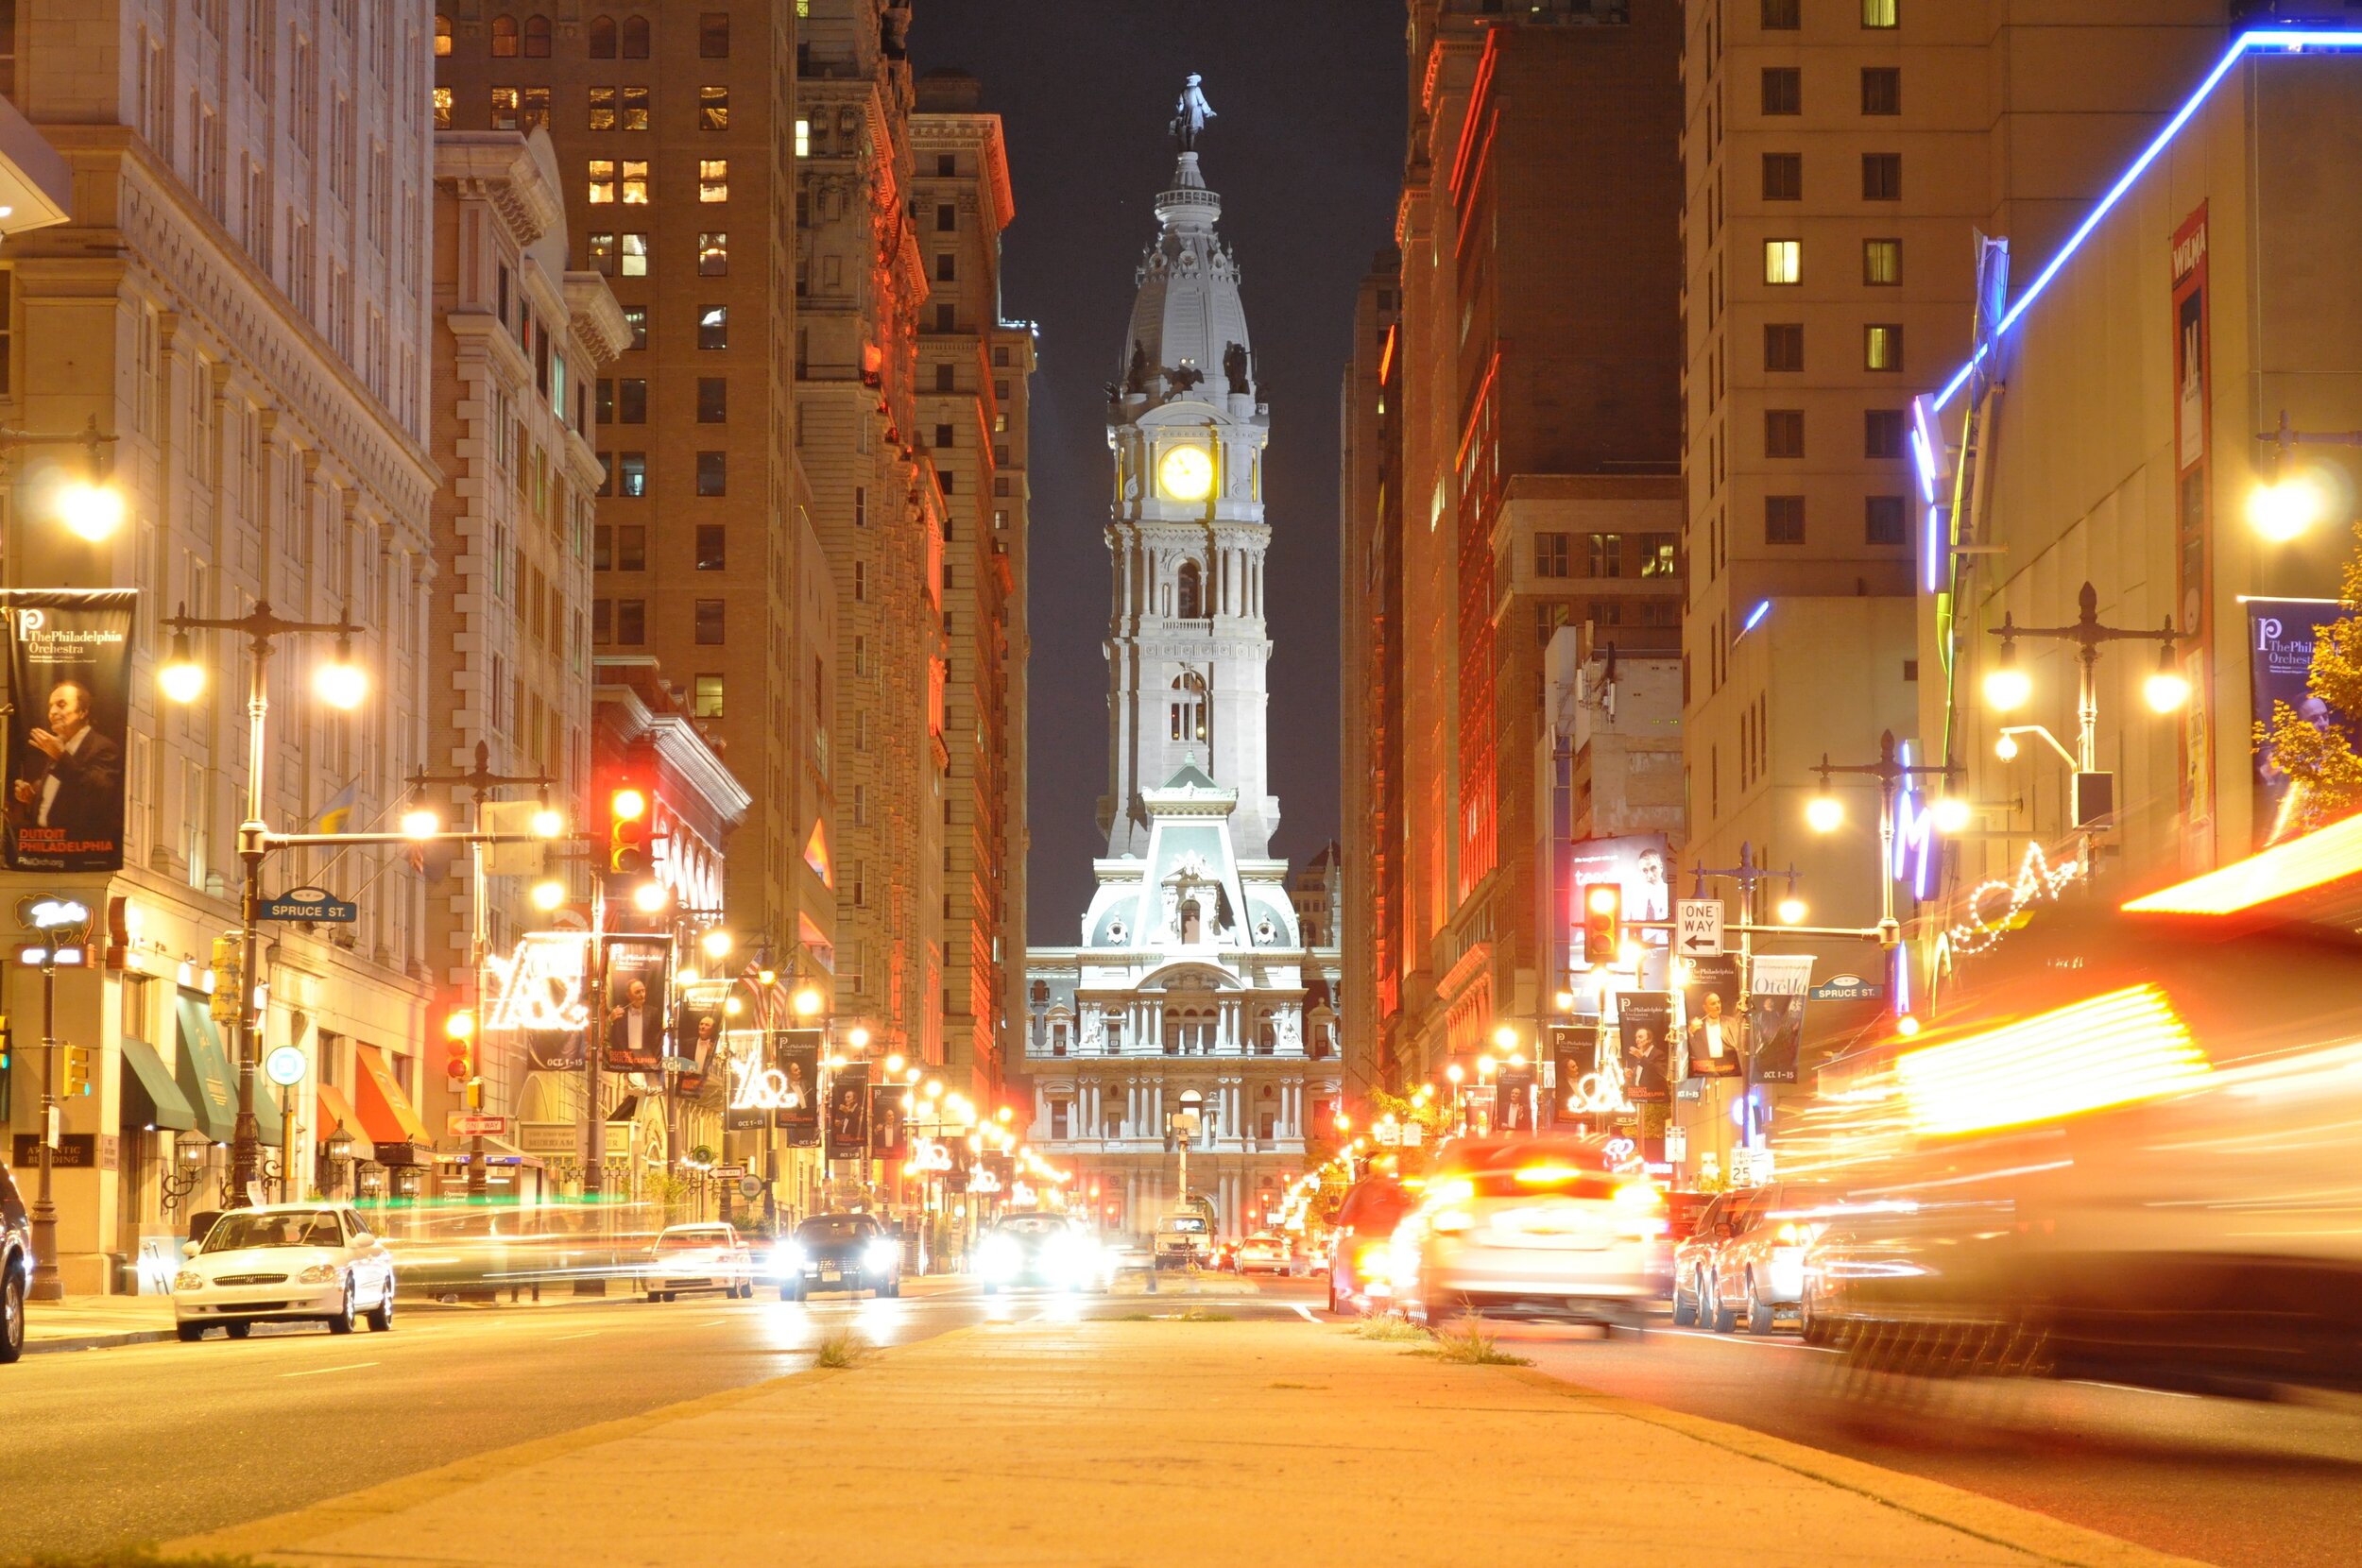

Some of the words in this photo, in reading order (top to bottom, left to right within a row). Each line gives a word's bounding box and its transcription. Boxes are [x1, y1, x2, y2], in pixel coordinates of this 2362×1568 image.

[2173, 223, 2206, 279] WILMA
[29, 642, 83, 654] Orchestra
[2269, 652, 2313, 664] Orchest
[20, 829, 66, 839] DUTOIT
[19, 840, 112, 852] PHILADELPHIA
[272, 906, 322, 916] SPRUCE
[328, 908, 346, 917] ST.
[1686, 905, 1713, 917] ONE
[1685, 920, 1714, 932] WAY
[1754, 977, 1806, 994] Otello
[1819, 989, 1857, 998] SPRUCE
[484, 1121, 500, 1130] WAY
[27, 1146, 81, 1155] ATNTIC
[28, 1155, 78, 1165] BUDING
[1733, 1167, 1750, 1181] 25
